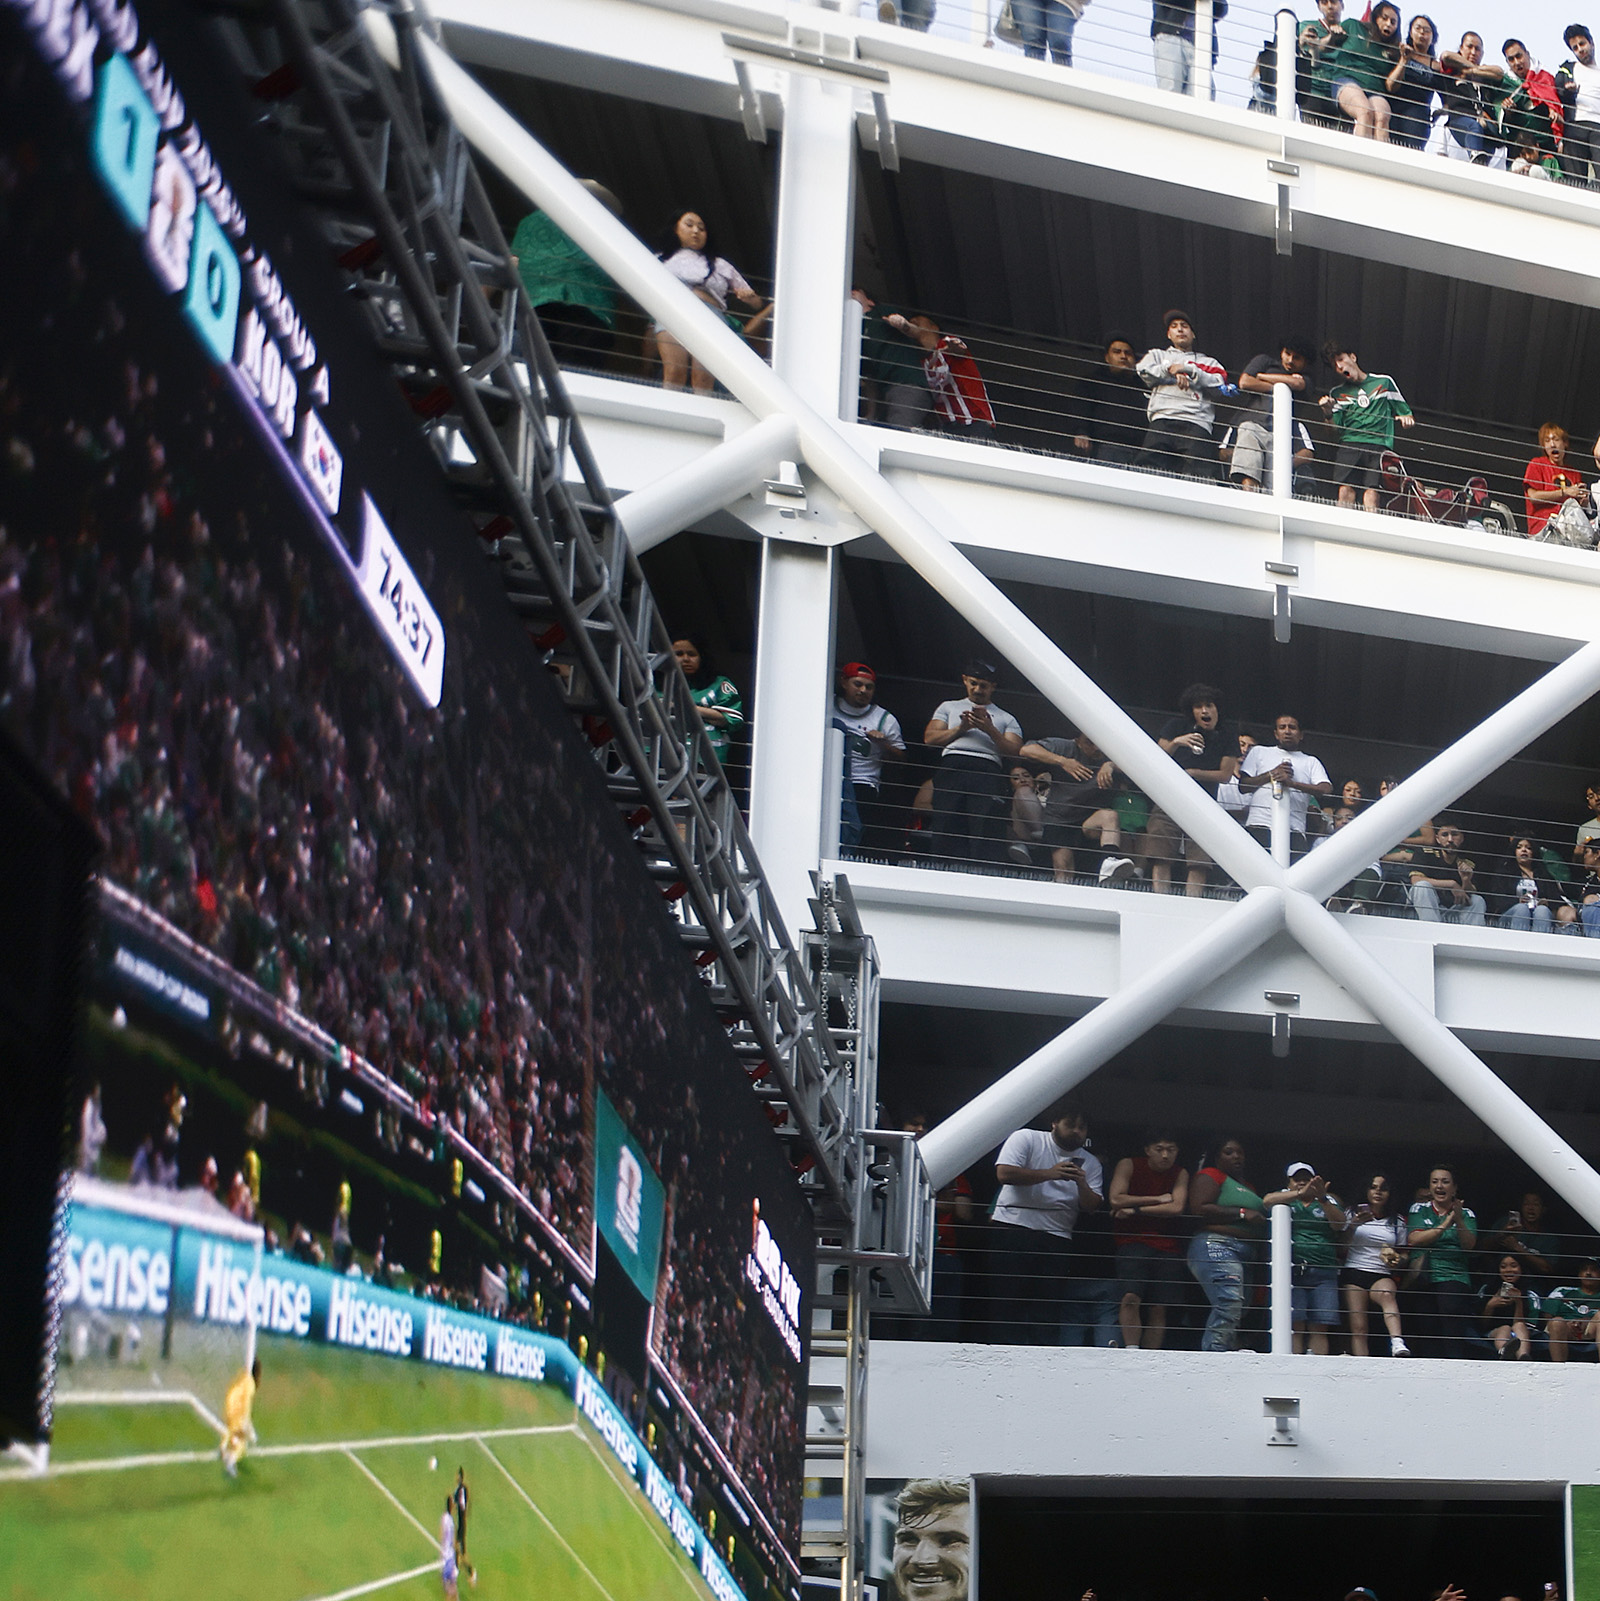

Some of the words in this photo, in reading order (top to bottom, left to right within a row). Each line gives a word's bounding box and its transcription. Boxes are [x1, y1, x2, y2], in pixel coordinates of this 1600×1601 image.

[121, 104, 141, 173] 1
[205, 250, 228, 321] 0
[249, 247, 318, 370] GROUP
[309, 360, 330, 406] A
[239, 306, 298, 439] KOR
[60, 1233, 171, 1314] sense
[193, 1240, 311, 1337] Hisense
[327, 1277, 414, 1356] Hisense
[422, 1305, 488, 1371] Hisense
[495, 1324, 546, 1381] Hisense
[576, 1364, 638, 1476] Hisense
